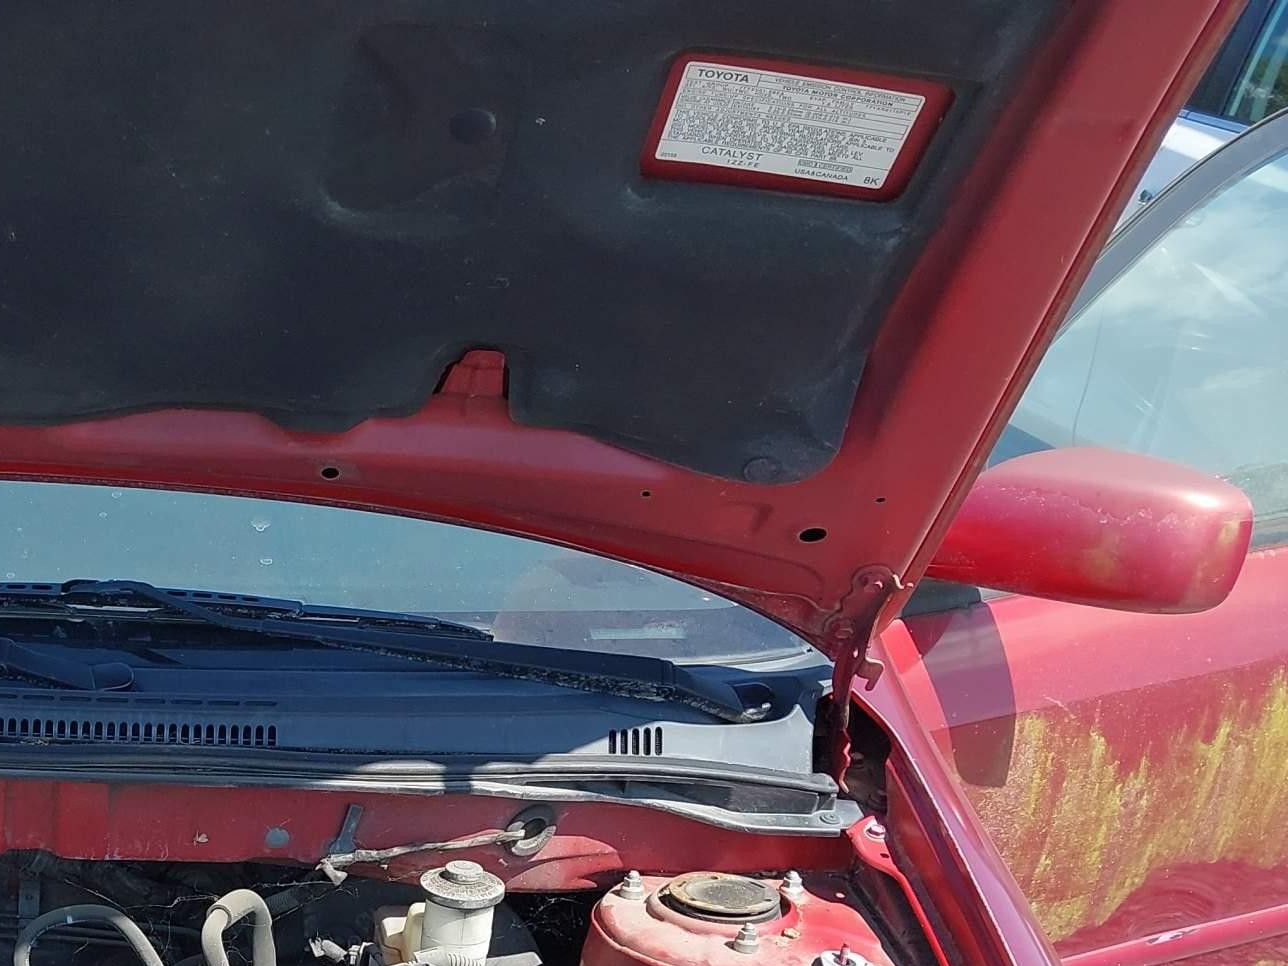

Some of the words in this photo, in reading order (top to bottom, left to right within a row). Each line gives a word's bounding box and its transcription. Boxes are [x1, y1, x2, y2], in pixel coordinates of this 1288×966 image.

[696, 67, 751, 83] TOYOTA
[781, 85, 809, 93] TOYOTA
[810, 89, 838, 97] MOTOR
[839, 94, 894, 106] CORPORATION
[700, 145, 764, 161] CATALYST
[862, 176, 881, 185] 8K
